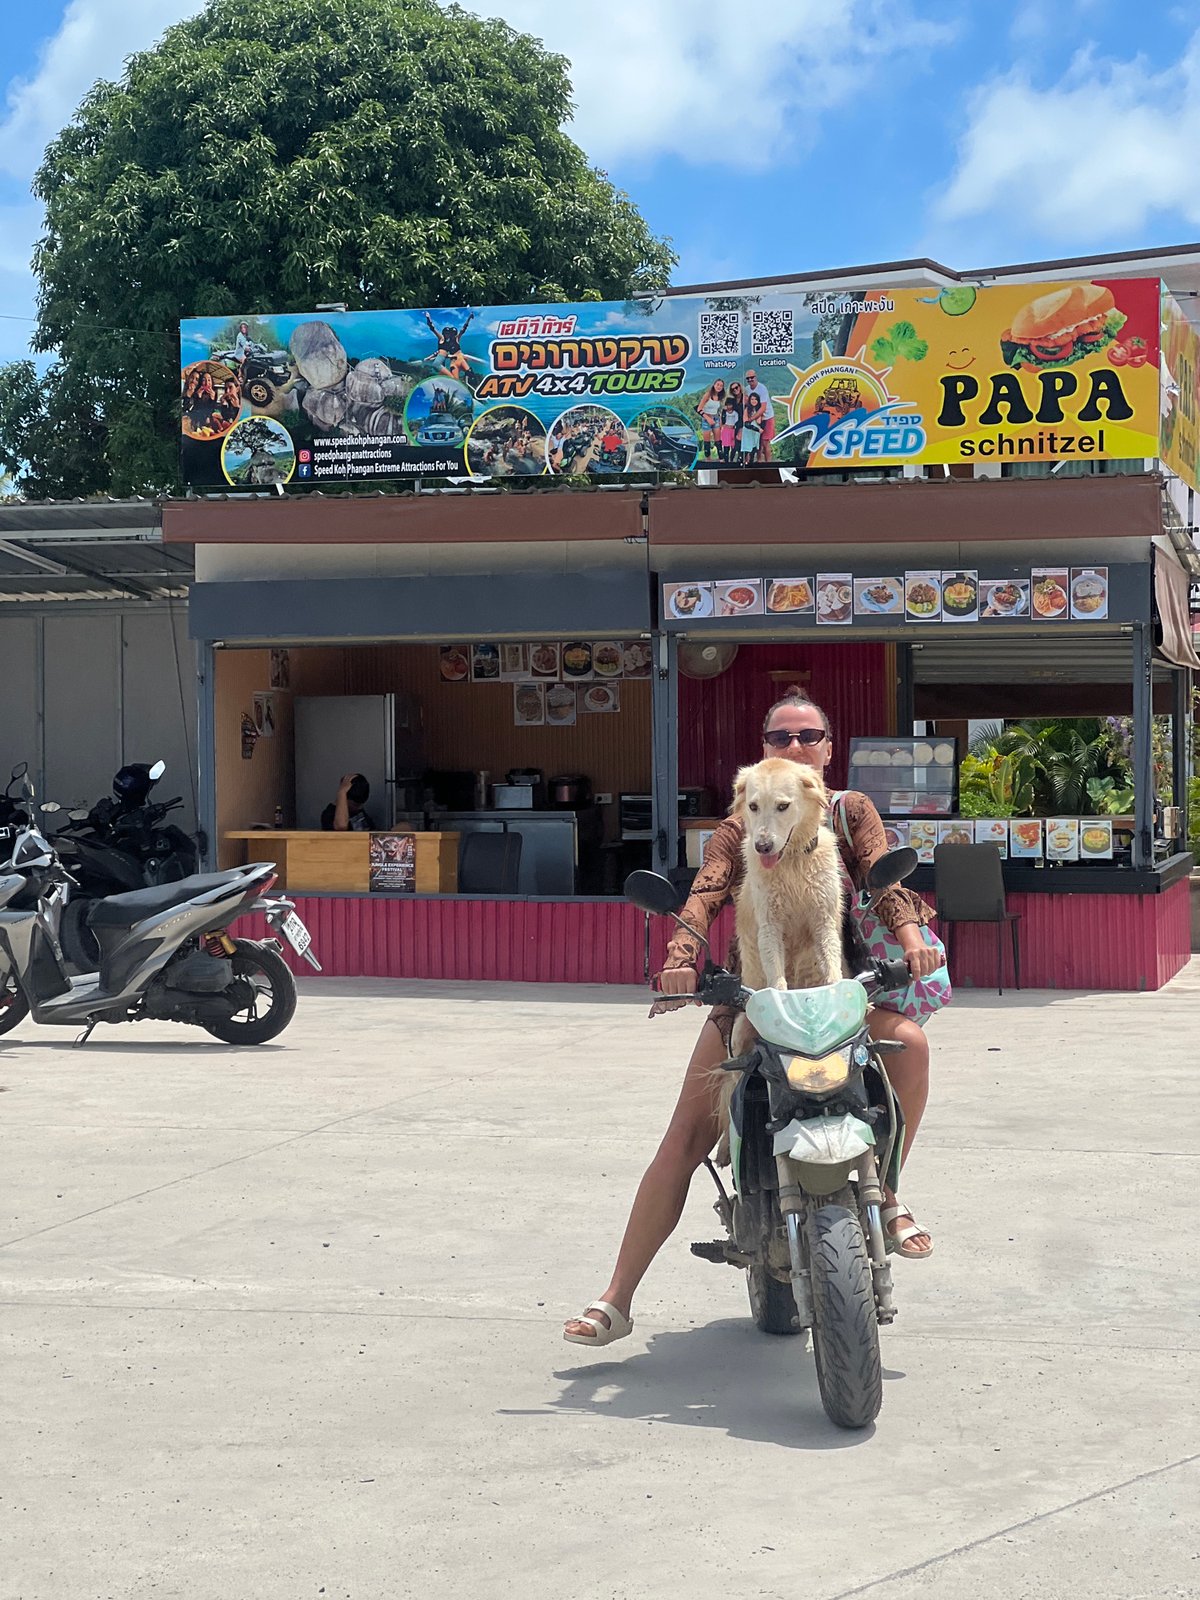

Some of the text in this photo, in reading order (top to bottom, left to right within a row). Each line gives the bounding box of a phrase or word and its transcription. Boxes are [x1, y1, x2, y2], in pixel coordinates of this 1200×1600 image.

[811, 299, 836, 314] สปีด
[496, 338, 685, 369] טרקטורונים
[759, 359, 786, 367] Location
[704, 360, 737, 369] WhatsApp
[480, 371, 681, 395] ATV 4x4 TOURS
[806, 366, 855, 387] KOH PHANGAN
[937, 368, 1134, 426] PAPA
[881, 415, 922, 426] ספיד
[314, 434, 407, 448] www.speedkohphangan.com
[826, 428, 922, 455] SPEED
[960, 430, 1104, 456] schnitzel
[314, 460, 459, 477] Speed Koh Phangan Extreme Attractions For You
